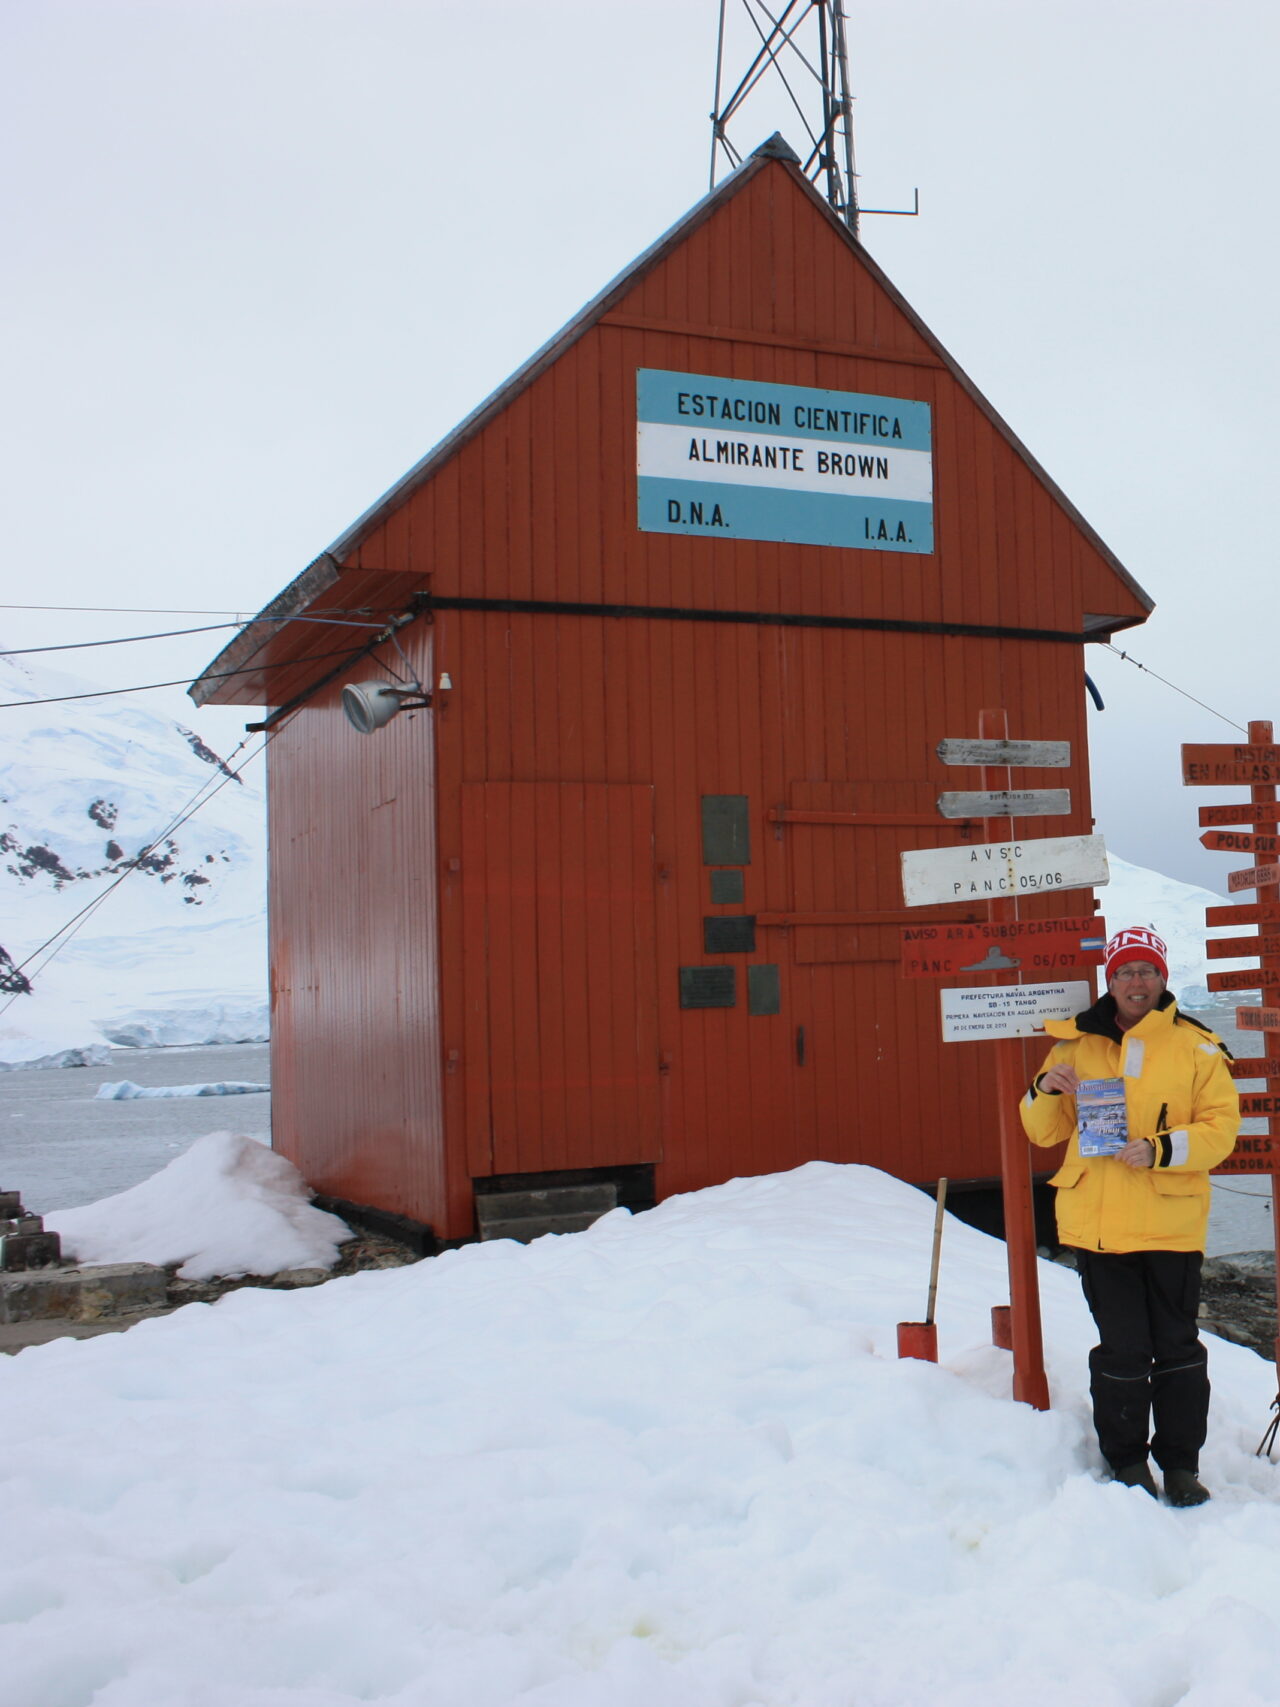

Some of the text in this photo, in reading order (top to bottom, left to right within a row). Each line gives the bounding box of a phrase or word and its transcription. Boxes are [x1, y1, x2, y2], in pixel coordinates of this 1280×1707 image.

[677, 393, 903, 440] ESTACION CIENTIFICA
[688, 438, 889, 480] ALMIRANTE BROWN
[667, 499, 914, 544] D.N.A. I.A.A.
[1187, 763, 1209, 782] EN
[1214, 763, 1272, 782] MILLAS
[1216, 834, 1251, 850] POLO
[1254, 836, 1277, 851] SUR
[953, 872, 1063, 895] PANC 05/06
[911, 953, 1077, 973] PANC 06/07
[1219, 970, 1280, 989] USHUAIA
[960, 988, 1065, 1001] PREFECTURA NAVAL ARGENTINA
[1230, 1062, 1253, 1076] UEVA
[1233, 1137, 1273, 1154] ONES
